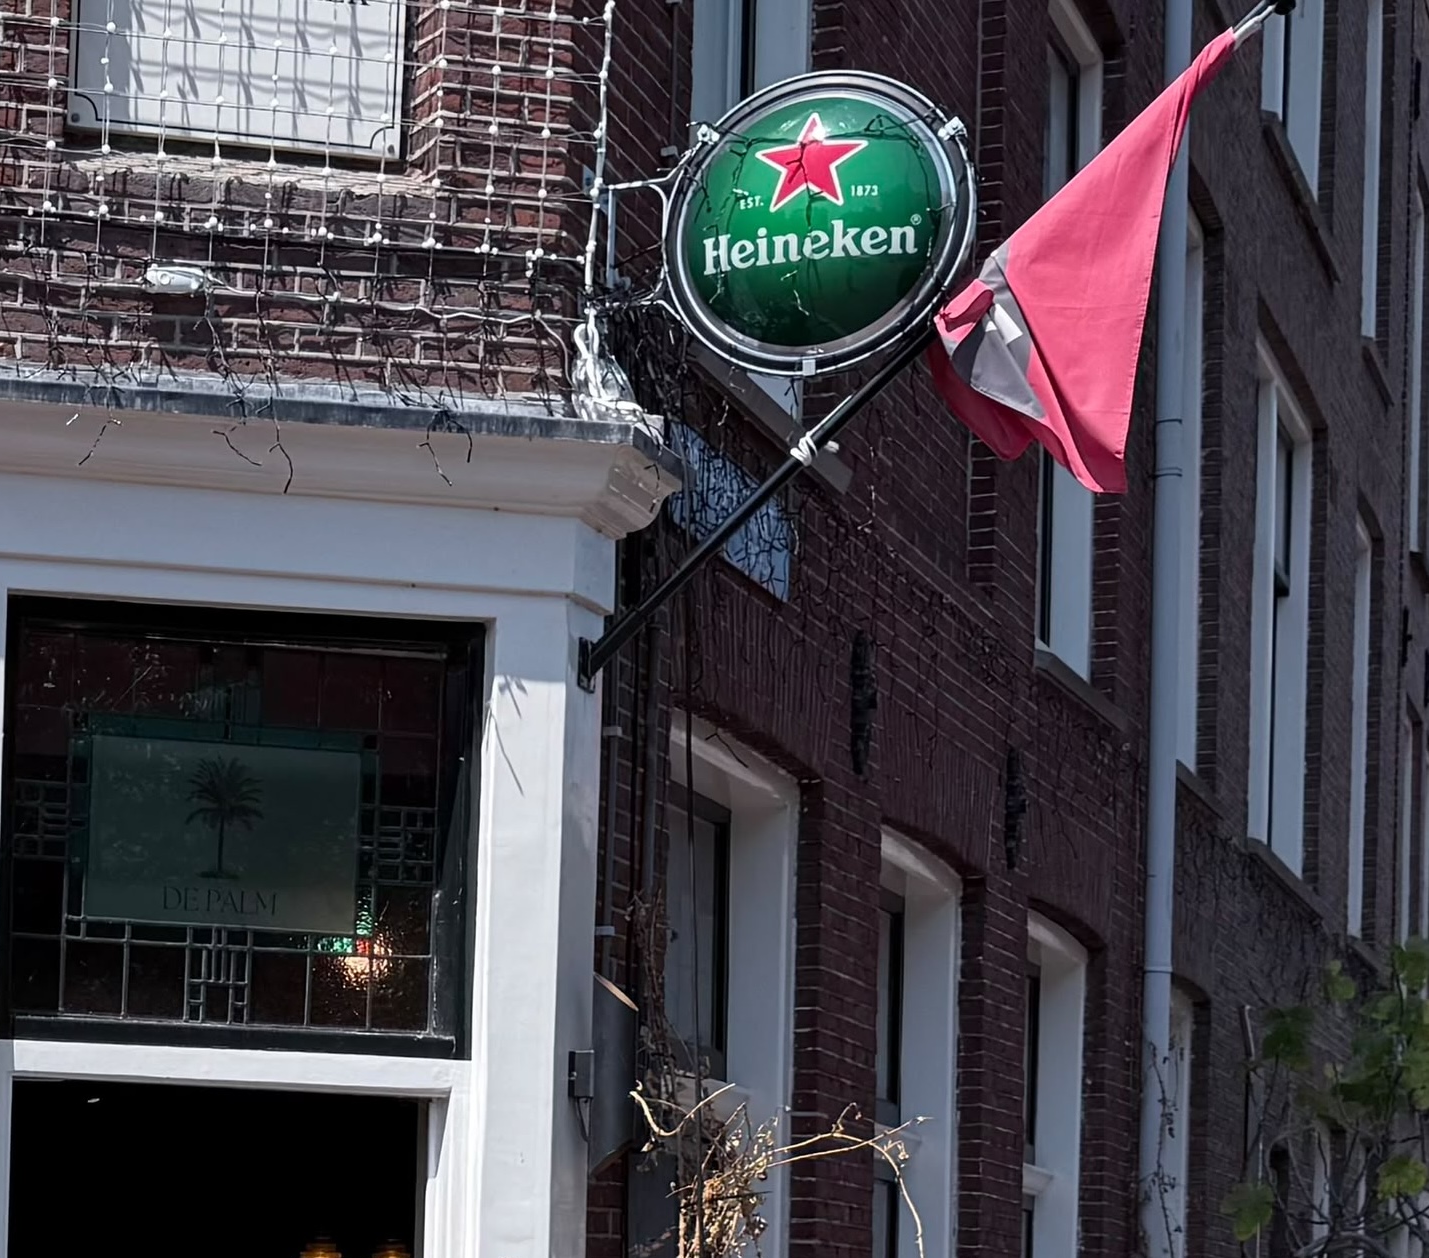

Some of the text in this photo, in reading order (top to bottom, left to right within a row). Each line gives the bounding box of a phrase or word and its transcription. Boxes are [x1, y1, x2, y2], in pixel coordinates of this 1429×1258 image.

[850, 184, 880, 198] 1873
[739, 195, 765, 210] EST.
[162, 884, 277, 917] DE PALM
